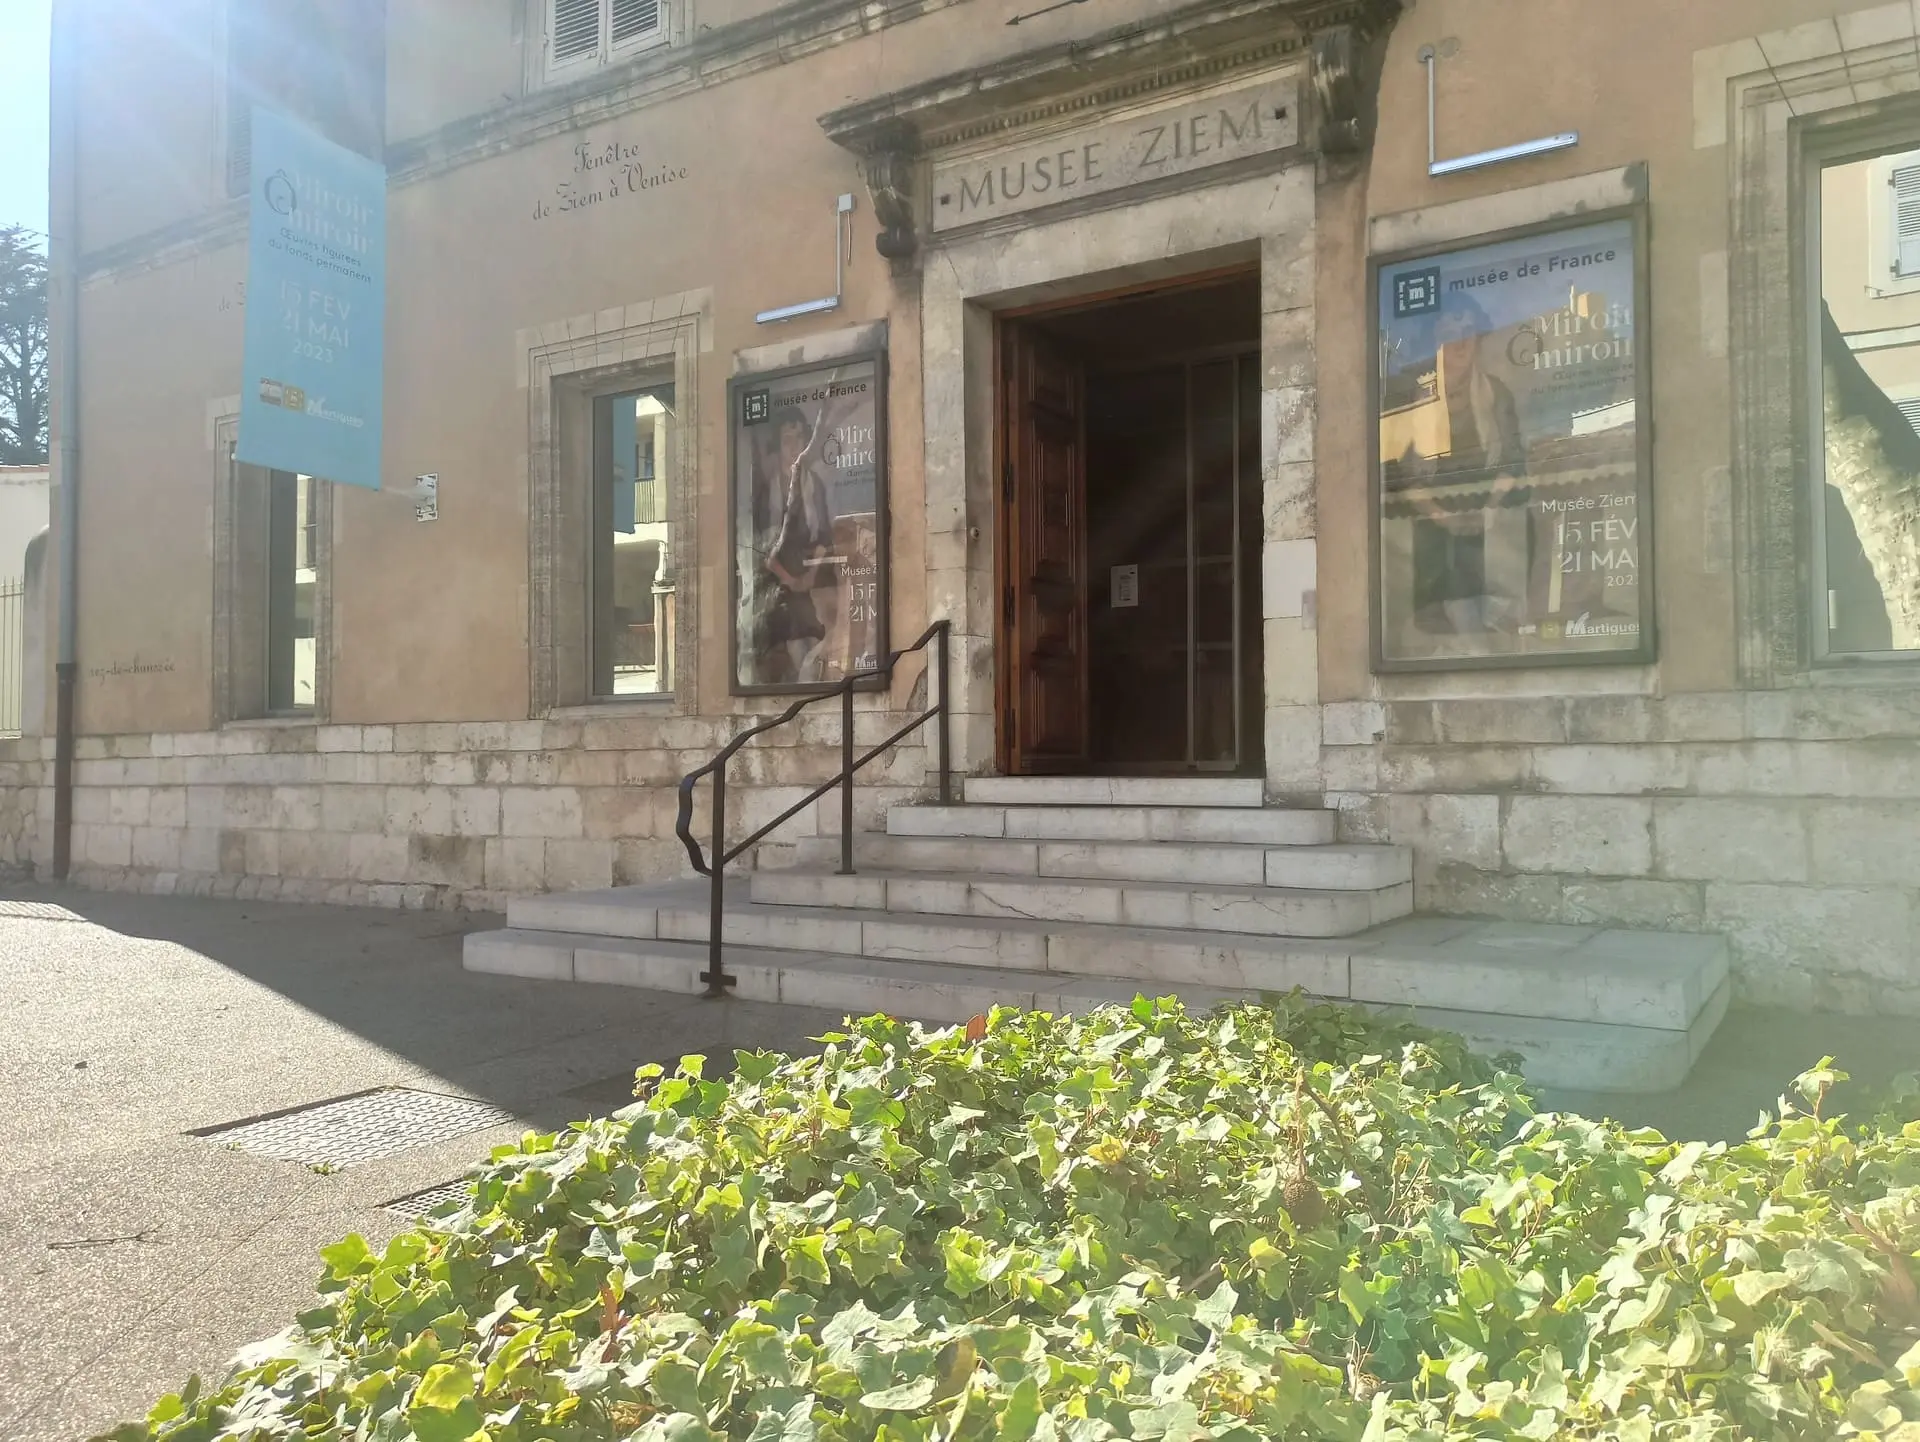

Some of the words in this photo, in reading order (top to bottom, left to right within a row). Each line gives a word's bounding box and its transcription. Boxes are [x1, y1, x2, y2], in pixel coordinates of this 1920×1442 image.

[573, 142, 640, 174] Fenêtre
[959, 143, 1103, 213] MUSEE
[1138, 101, 1264, 168] ZIEM
[532, 200, 551, 221] de
[609, 179, 620, 198] à
[620, 162, 690, 193] Venise
[1449, 269, 1509, 292] musée
[1517, 261, 1541, 279] de
[1548, 250, 1616, 272] France
[308, 316, 350, 348] MAI
[811, 388, 825, 401] de
[828, 383, 867, 399] France
[1541, 496, 1594, 514] Musée
[1556, 520, 1584, 546] 15
[1590, 514, 1637, 543] FÉV
[841, 565, 871, 576] Musée
[1556, 551, 1582, 574] 21
[849, 583, 864, 601] 15
[1607, 574, 1638, 588] 202
[849, 604, 864, 622] 21
